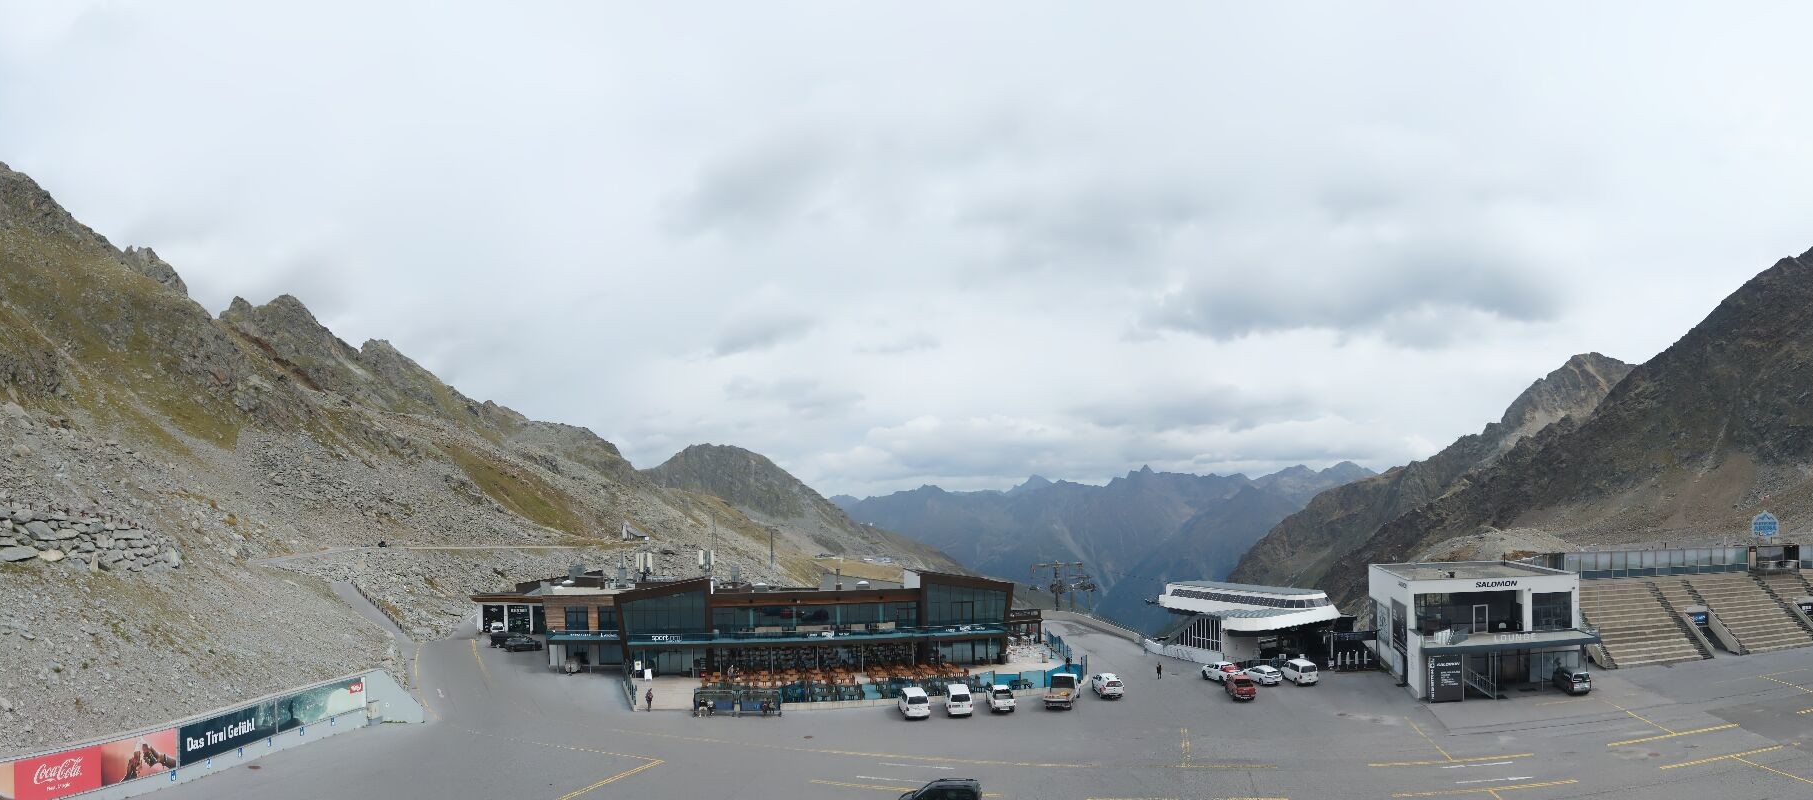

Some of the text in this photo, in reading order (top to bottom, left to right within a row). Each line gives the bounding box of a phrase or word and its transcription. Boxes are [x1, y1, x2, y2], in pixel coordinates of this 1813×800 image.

[1476, 580, 1518, 588] SALOMON
[651, 634, 669, 642] sport
[1494, 633, 1537, 641] LOUNGE
[186, 717, 256, 752] Das Tirol Gefühl
